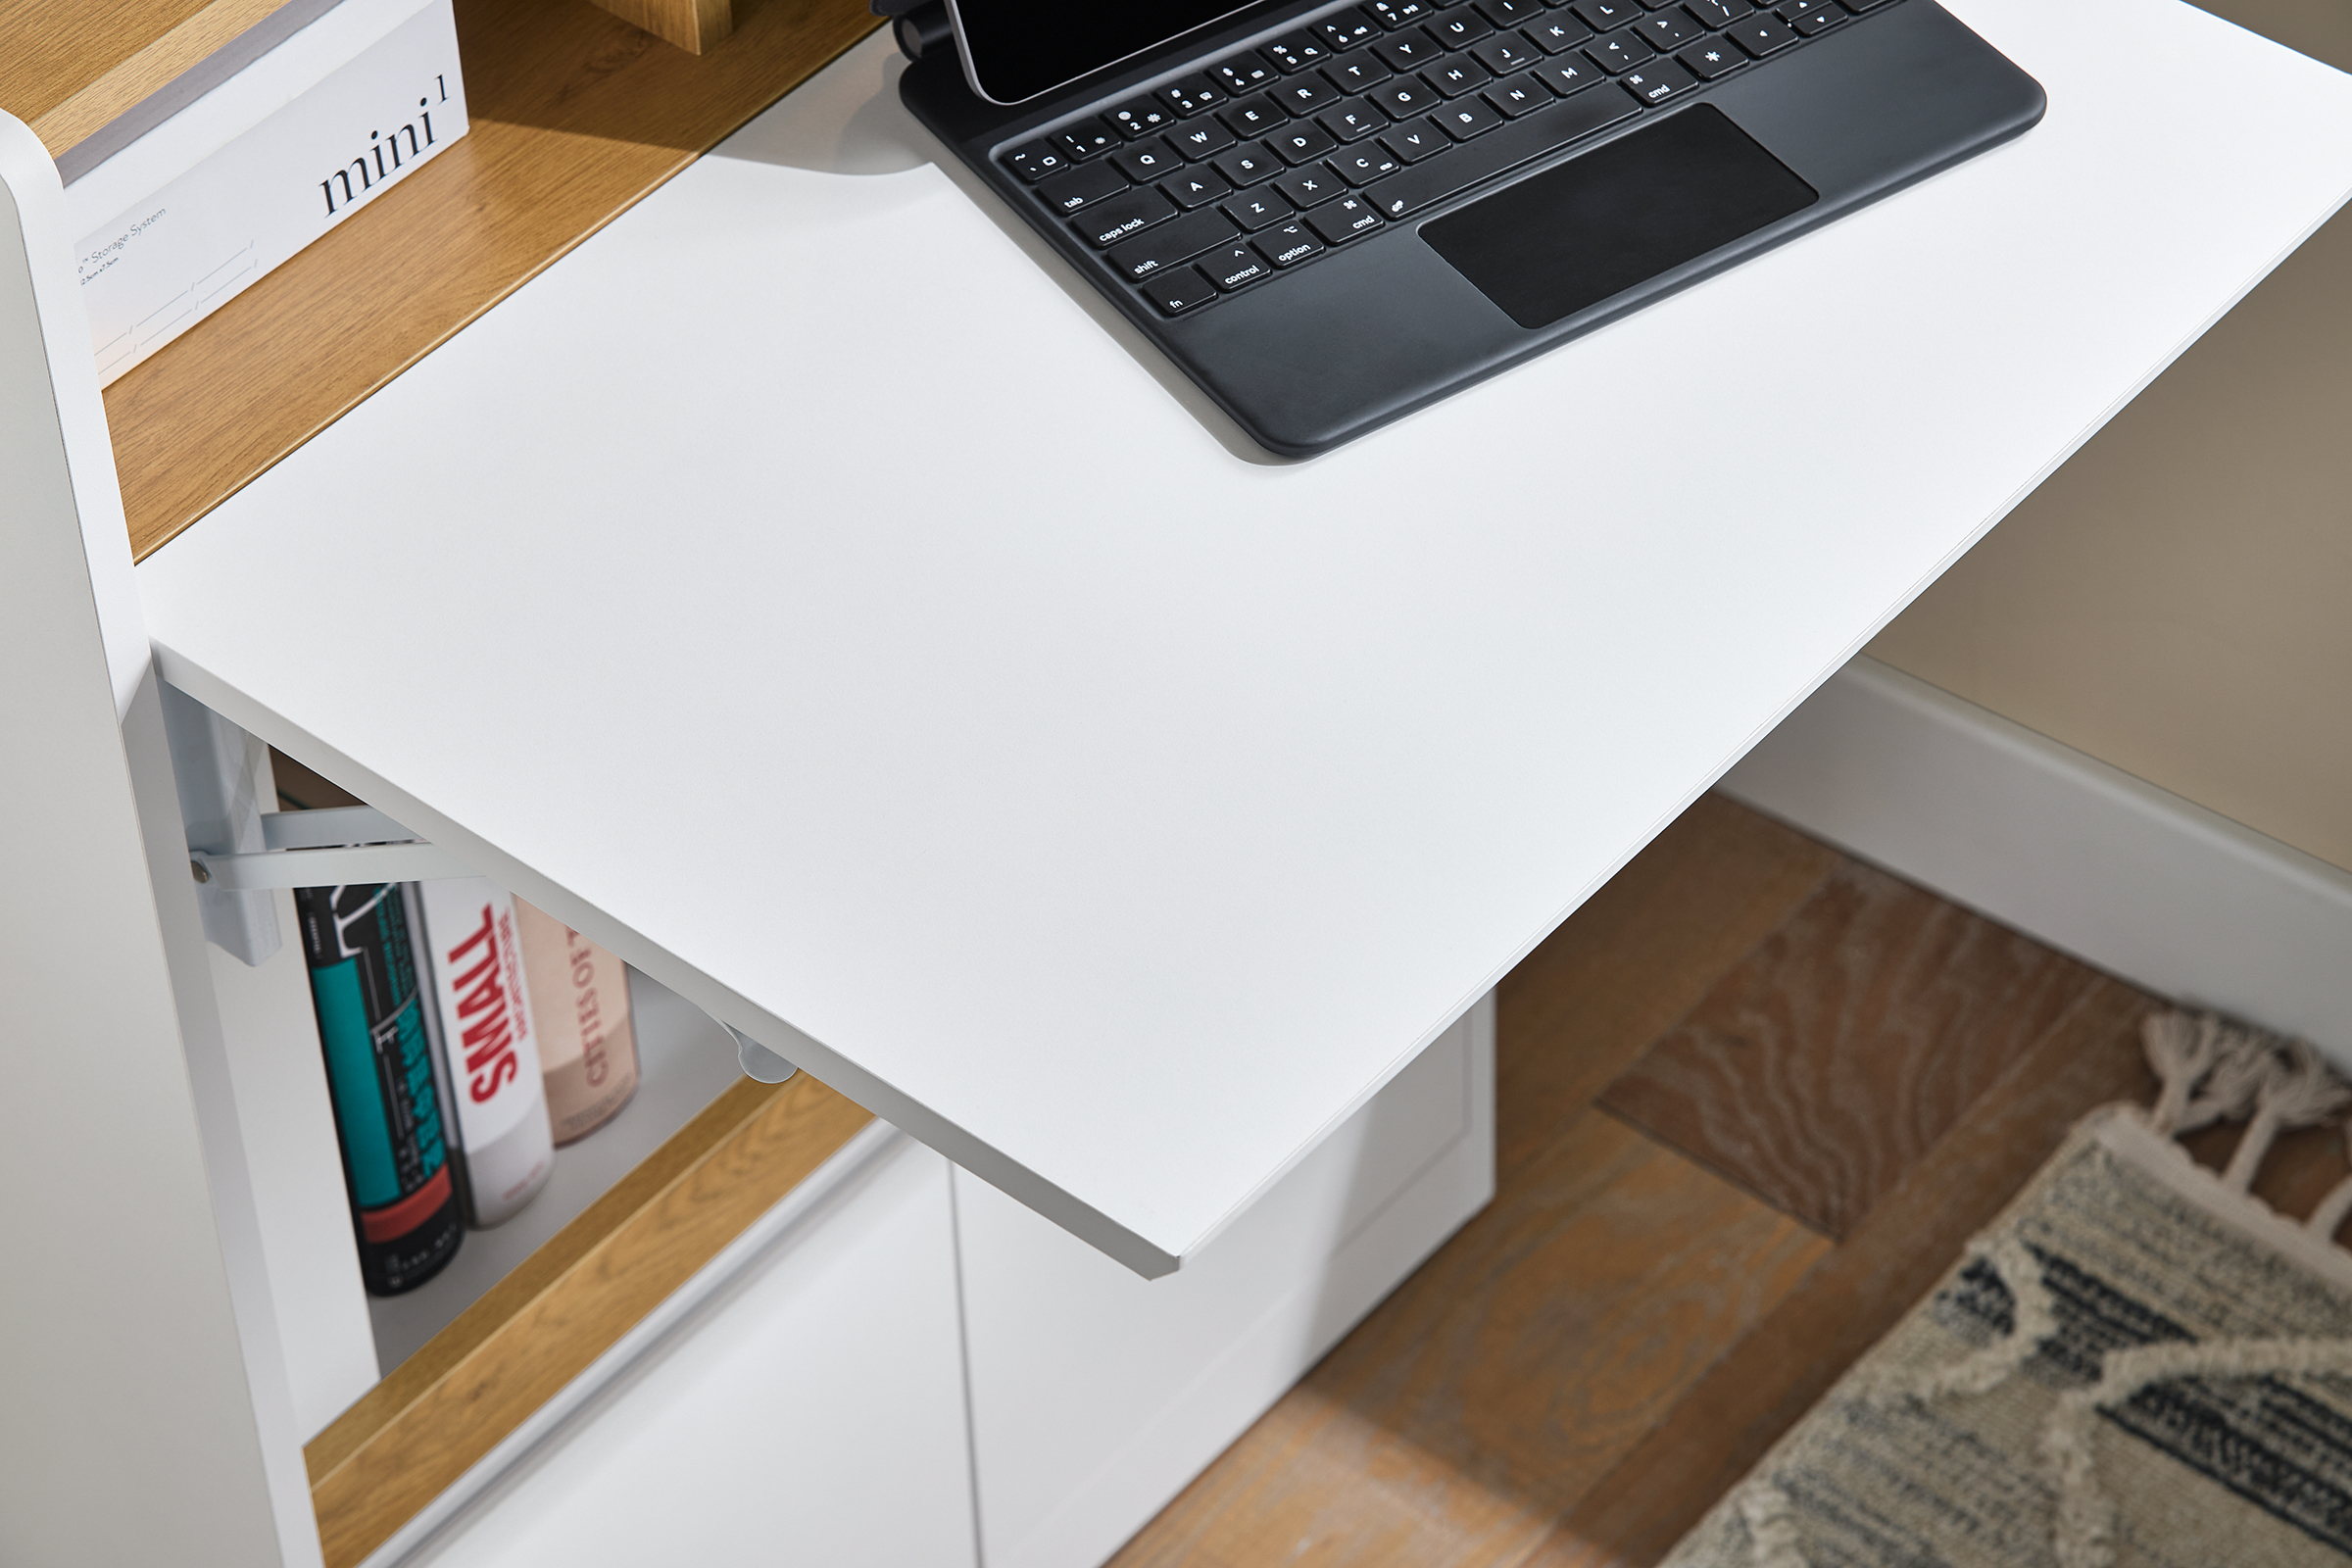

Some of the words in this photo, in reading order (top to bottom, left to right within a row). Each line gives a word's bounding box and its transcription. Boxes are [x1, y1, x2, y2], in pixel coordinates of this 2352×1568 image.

[1599, 6, 1614, 15] L
[1387, 12, 1397, 22] 7
[1449, 22, 1464, 32] U
[1549, 25, 1565, 37] K
[1338, 34, 1348, 43] 6
[1398, 43, 1412, 54] Y
[1501, 48, 1511, 59] J
[1286, 56, 1298, 65] 5
[1348, 66, 1361, 76] T
[1447, 69, 1463, 80] H
[1560, 67, 1578, 79] M
[1297, 88, 1312, 99] R
[1397, 92, 1411, 102] G
[1509, 89, 1525, 101] N
[1648, 83, 1672, 100] cmd
[1181, 100, 1193, 109] 3
[1245, 111, 1259, 122] E
[1345, 114, 1356, 125] F
[1458, 113, 1473, 123] B
[1130, 122, 1142, 130] 2
[1190, 131, 1207, 143] W
[1293, 137, 1306, 148] D
[1406, 134, 1420, 144] V
[318, 97, 438, 219] mini
[1140, 155, 1155, 165] Q
[1355, 158, 1369, 168] C
[1241, 160, 1254, 170] S
[1190, 181, 1203, 192] A
[1302, 179, 1318, 191] X
[1063, 197, 1084, 208] tab
[1250, 202, 1265, 214] Z
[1352, 215, 1377, 231] cmd
[1099, 225, 1124, 242] caps
[1120, 218, 1145, 232] lock
[90, 234, 128, 264] Storage
[129, 208, 166, 236] System
[1278, 244, 1311, 263] option
[1134, 260, 1159, 274] shift
[1224, 265, 1260, 284] control
[1169, 300, 1184, 309] fn
[570, 949, 594, 990] OF
[447, 901, 519, 1105] SMALL
[575, 987, 611, 1088] CITIES
